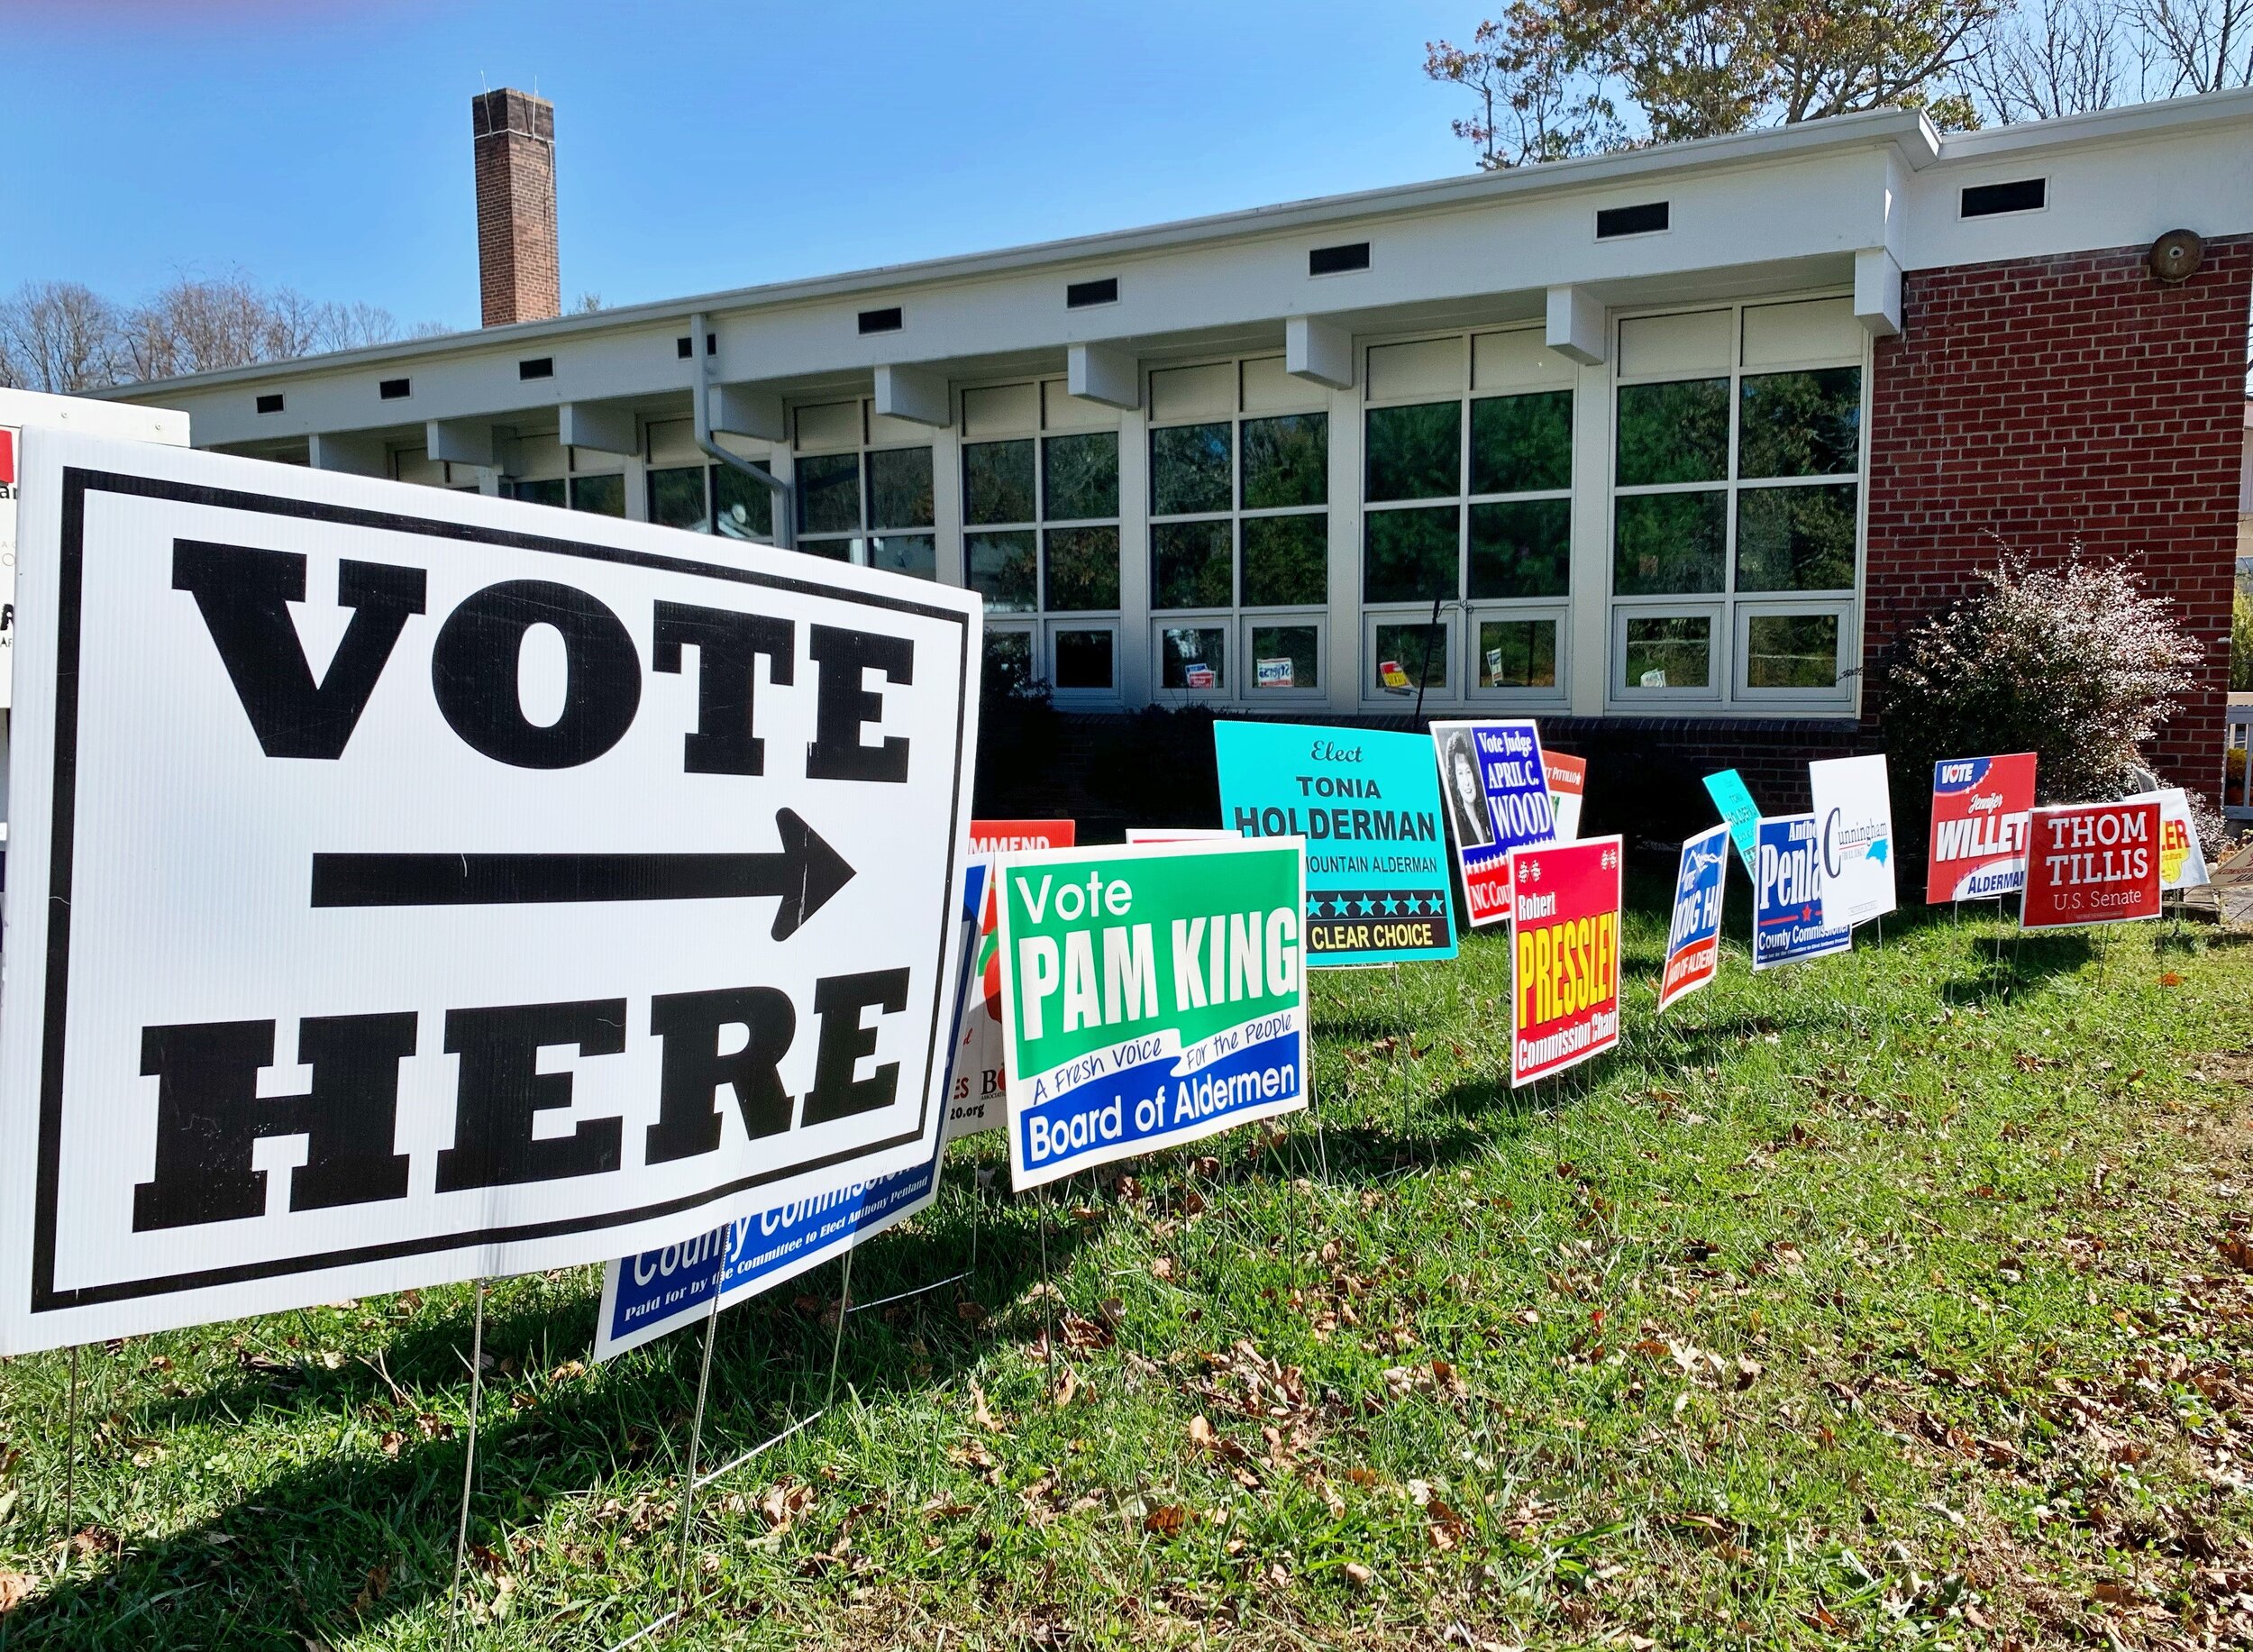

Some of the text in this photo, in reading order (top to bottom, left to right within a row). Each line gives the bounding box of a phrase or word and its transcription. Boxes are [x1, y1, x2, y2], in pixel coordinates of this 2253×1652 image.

[171, 537, 916, 783] VOTE
[1309, 739, 1364, 763] Elect
[1477, 730, 1533, 758] Vote Judge
[1295, 776, 1382, 799] TONIA
[1487, 761, 1528, 789] APRIL
[1526, 760, 1540, 786] C.
[1941, 762, 1975, 785] VOTE
[1488, 791, 1552, 841] WOOD
[1967, 792, 2003, 815] Jennifer
[1234, 806, 1437, 843] HOLDERMAN
[1823, 807, 1888, 879] Cunningham
[1935, 810, 2029, 863] WILLET
[2048, 811, 2148, 850] THOM
[2161, 819, 2191, 851] ER
[1372, 855, 1438, 873] ALDERMAN
[1759, 839, 1823, 910] Penla
[2045, 847, 2148, 887] TILLIS
[1014, 870, 1133, 925] Vote
[1469, 882, 1491, 911] NC
[1518, 890, 1557, 922] Robert
[2053, 889, 2142, 910] U.S. Senate
[1311, 923, 1434, 951] CLEAR CHOICE
[1758, 927, 1792, 951] County
[1017, 906, 1298, 1042] PAM KING
[1518, 910, 1619, 1030] PRESSLEY
[1034, 1012, 1292, 1106] A Fresh Voice For the People
[1518, 1021, 1592, 1072] Commission
[1591, 1007, 1617, 1045] Chair
[132, 966, 911, 1234] HERE
[1029, 1062, 1296, 1163] Board of Aldermen
[625, 1174, 929, 1323] Paid for by the Committee to Elect Anthony Penland
